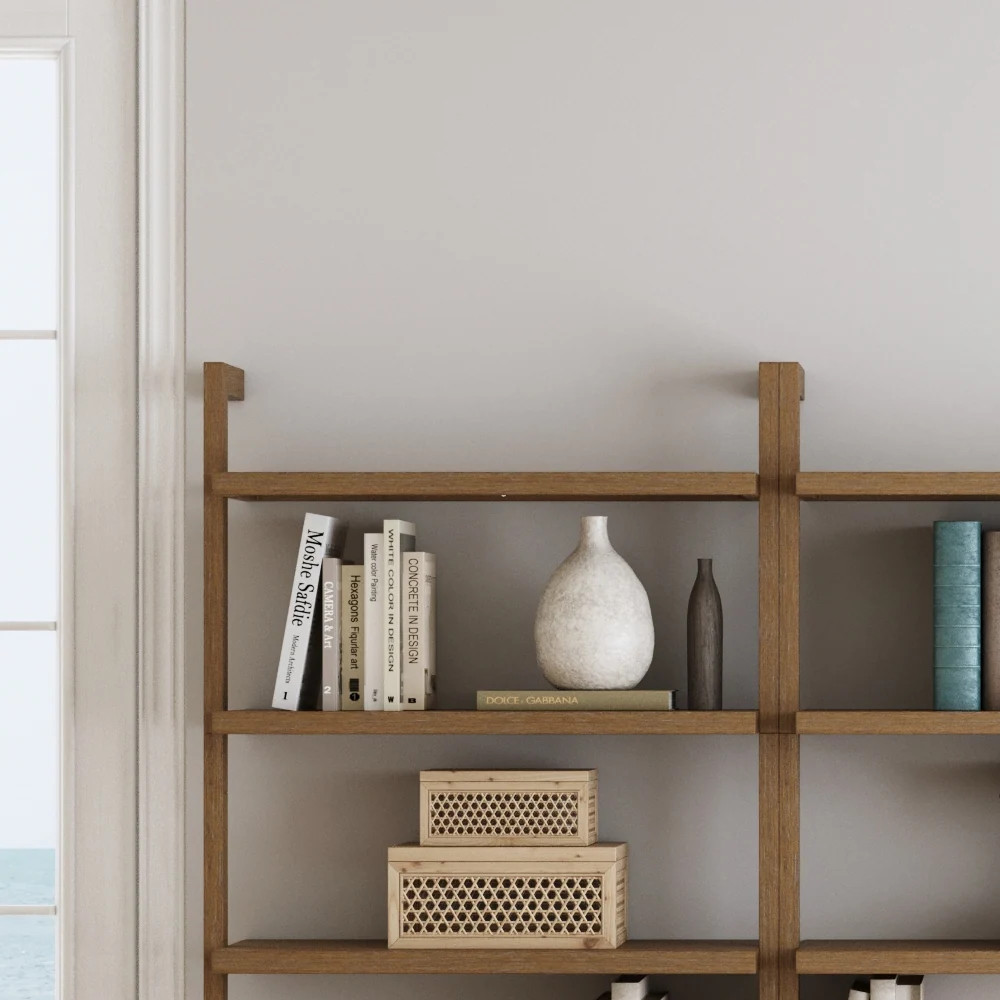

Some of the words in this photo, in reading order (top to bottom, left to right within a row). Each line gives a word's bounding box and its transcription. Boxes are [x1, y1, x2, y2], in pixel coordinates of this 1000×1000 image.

[300, 528, 325, 579] Moshe
[371, 543, 379, 562] Water
[371, 562, 379, 578] color
[369, 578, 379, 602] Painting
[408, 558, 419, 612] CONCRETE
[291, 582, 315, 627] Safdie
[324, 581, 335, 622] CAMERA
[348, 575, 361, 623] Hexagons
[388, 613, 394, 625] IN
[408, 615, 419, 625] IN
[324, 634, 334, 649] Art
[408, 627, 419, 664] DESIGN
[350, 658, 359, 670] art
[486, 696, 520, 705] DOLCE
[526, 696, 579, 705] GABBANA
